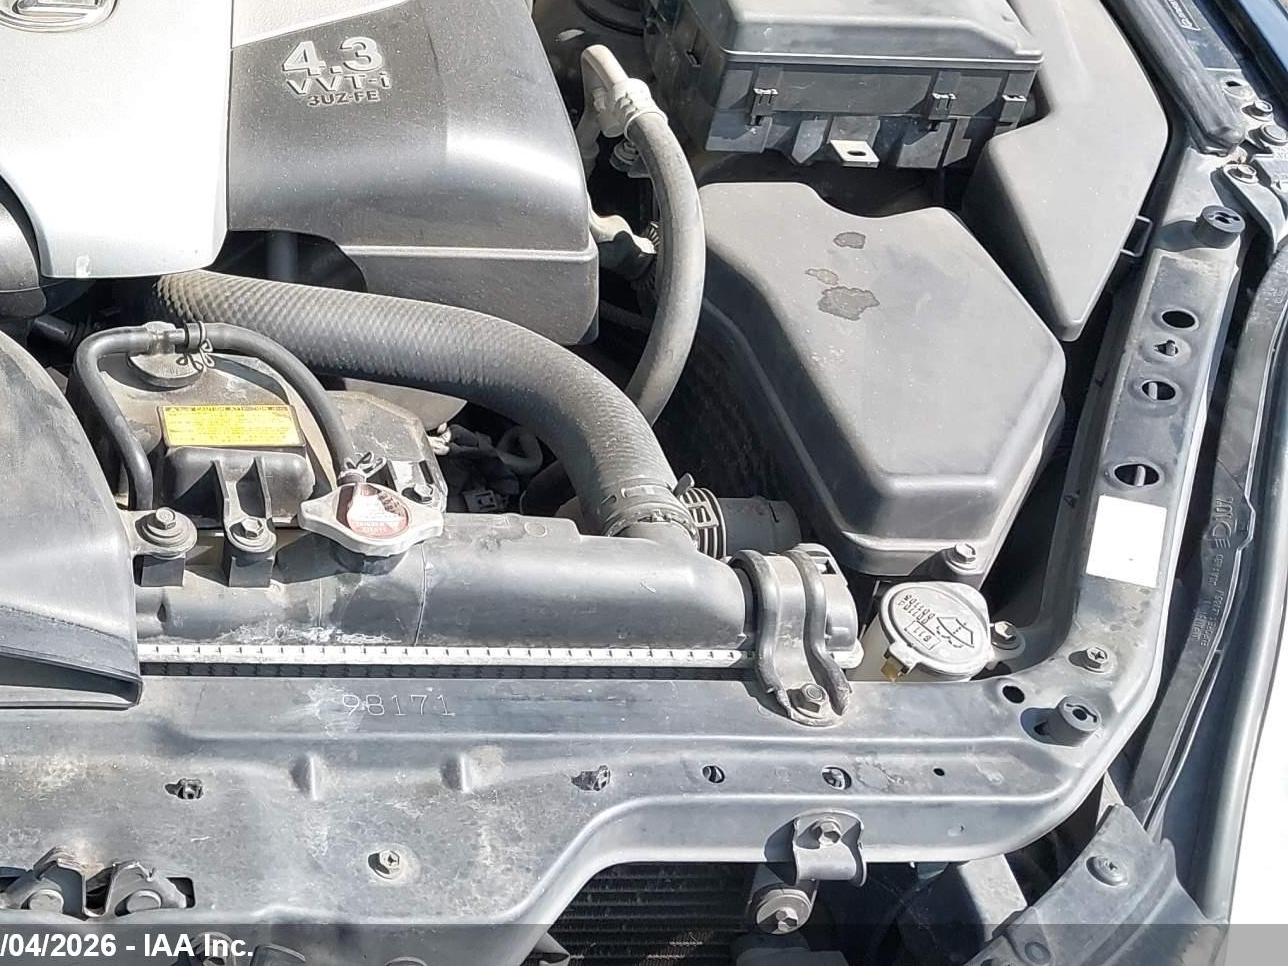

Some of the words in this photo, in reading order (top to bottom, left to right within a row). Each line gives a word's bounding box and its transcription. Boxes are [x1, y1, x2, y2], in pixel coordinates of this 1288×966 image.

[281, 35, 383, 77] 4.3
[286, 71, 391, 95] VVT-i
[307, 89, 380, 107] 3UZ-FE
[341, 693, 457, 716] 98171
